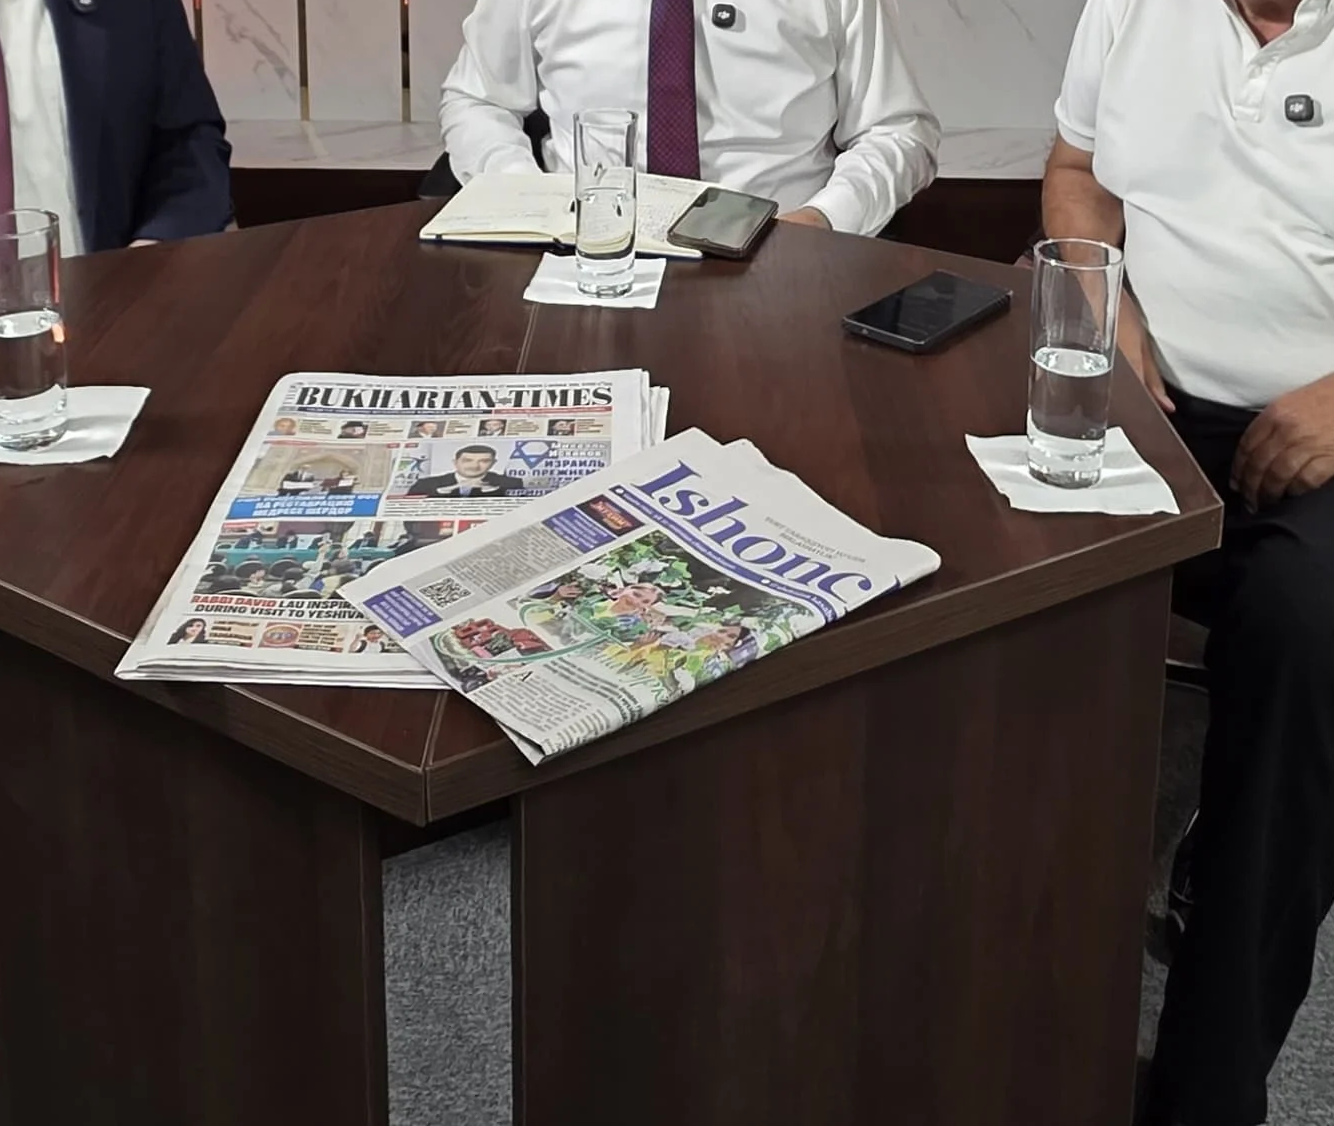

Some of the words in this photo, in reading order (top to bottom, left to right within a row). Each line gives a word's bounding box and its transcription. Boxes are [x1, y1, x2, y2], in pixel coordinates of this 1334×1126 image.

[296, 386, 499, 409] BUKHARIAN
[508, 386, 613, 408] TIMES
[531, 469, 601, 477] ПРЕЖНЕМ
[191, 594, 235, 606] RABBI
[234, 596, 278, 608] DAVID
[278, 599, 305, 609] LAU
[306, 600, 356, 610] INSPIR
[194, 604, 248, 614] DURING
[249, 607, 285, 617] VISIT
[287, 609, 306, 618] TO
